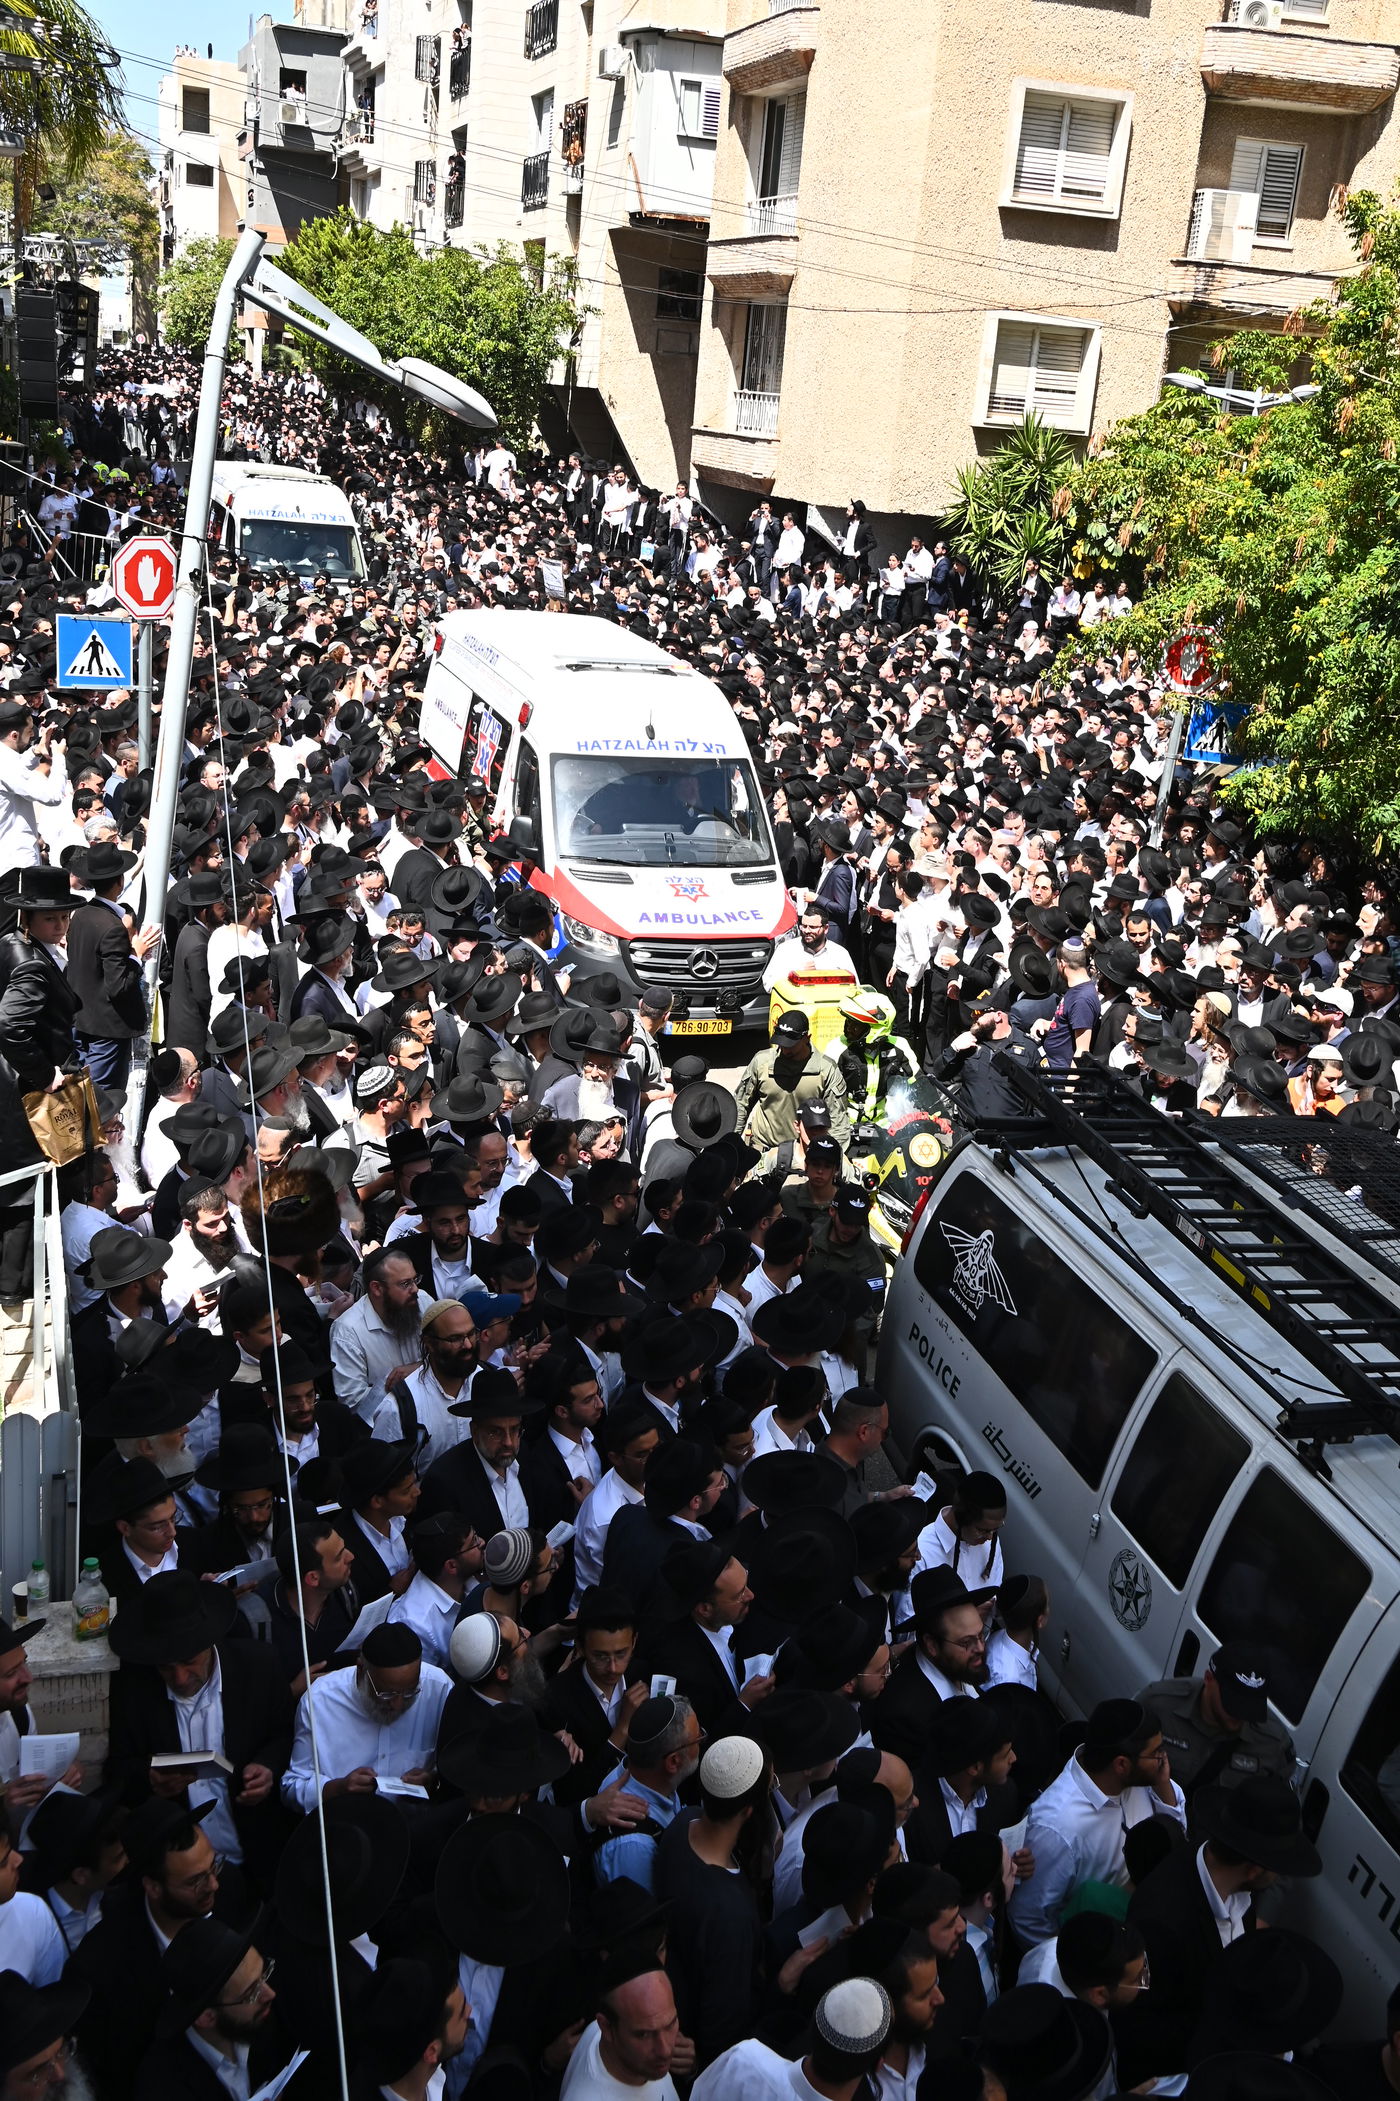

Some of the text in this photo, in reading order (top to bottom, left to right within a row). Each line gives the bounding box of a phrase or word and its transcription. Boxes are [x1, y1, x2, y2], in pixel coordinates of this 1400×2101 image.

[249, 508, 346, 522] HATZALAH הצלה
[480, 711, 502, 745] הצלה
[577, 738, 727, 755] HATZALAH הצלה
[664, 875, 704, 884] הצלה
[638, 909, 764, 925] AMBULANCE
[909, 1322, 961, 1400] POLICE
[982, 1421, 1042, 1500] الشرطة
